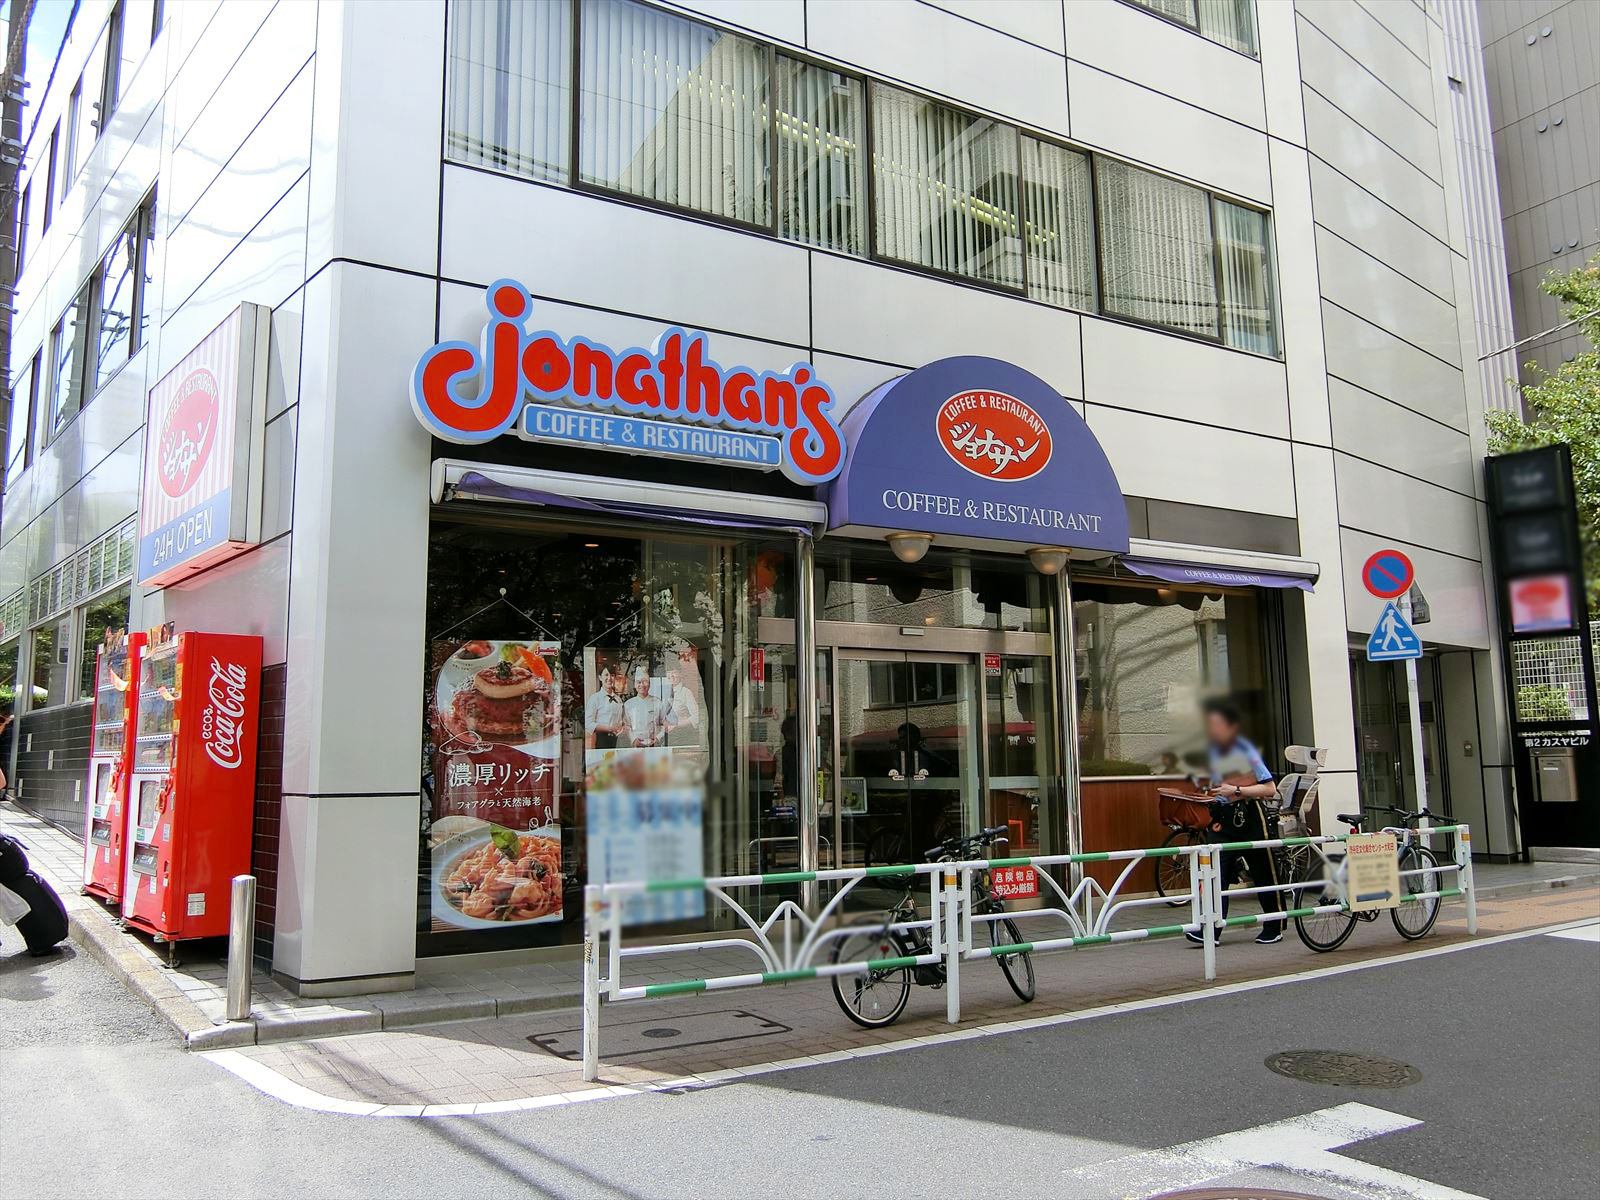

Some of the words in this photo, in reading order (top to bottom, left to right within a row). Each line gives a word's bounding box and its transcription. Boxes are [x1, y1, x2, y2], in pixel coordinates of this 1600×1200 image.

[536, 410, 615, 441] COFFEE
[621, 423, 636, 442] &
[643, 428, 771, 462] RESTAURANT
[944, 396, 977, 422] COFFEE
[980, 394, 987, 407] &
[989, 396, 1046, 437] RESTAURANT
[948, 421, 1041, 475] ジョナサン
[882, 489, 961, 517] COFFEE
[964, 500, 980, 519] &
[982, 501, 1102, 533] RESTAURANT
[152, 532, 174, 567] 24H
[176, 506, 214, 554] OPEN
[448, 762, 551, 788] 濃厚リッチ
[457, 796, 542, 810] フォアグラと天然海老
